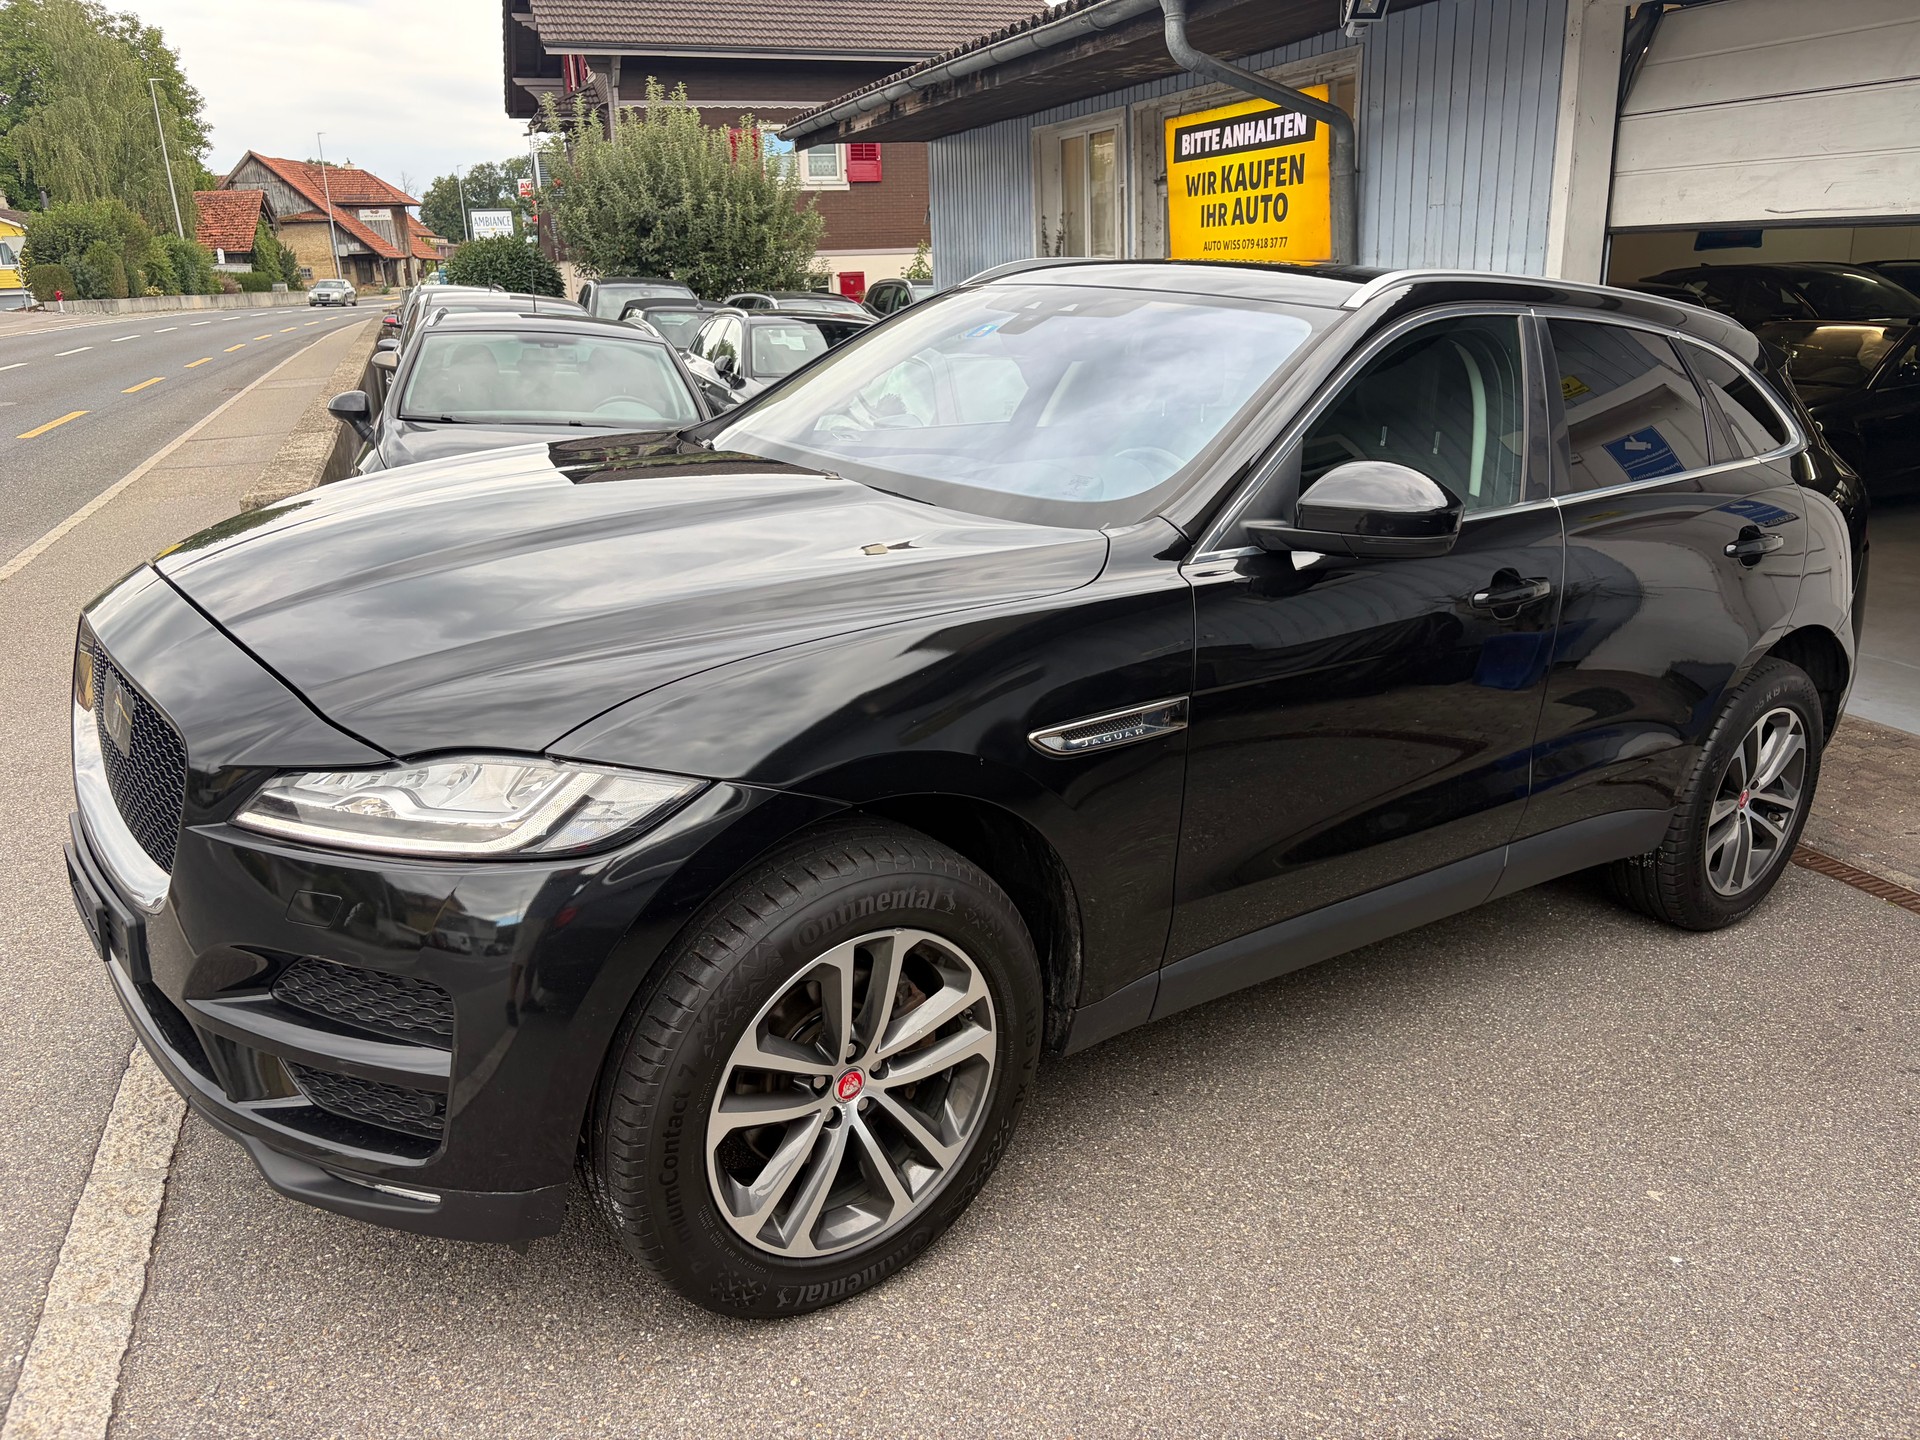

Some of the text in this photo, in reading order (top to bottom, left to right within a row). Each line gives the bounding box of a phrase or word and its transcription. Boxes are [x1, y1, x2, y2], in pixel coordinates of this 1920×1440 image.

[1181, 112, 1307, 156] BITTE ANHALTEN
[1185, 153, 1305, 198] WIR KAUFEN
[474, 216, 511, 227] AMBIANCE
[1201, 192, 1289, 228] IHR AUTO
[1203, 240, 1222, 252] AUTO
[1222, 238, 1241, 250] WISS
[1241, 237, 1255, 249] 079
[1255, 237, 1269, 249] 418
[1081, 728, 1144, 748] JAGUAR
[792, 885, 939, 951] Continental
[678, 1063, 698, 1079] 7
